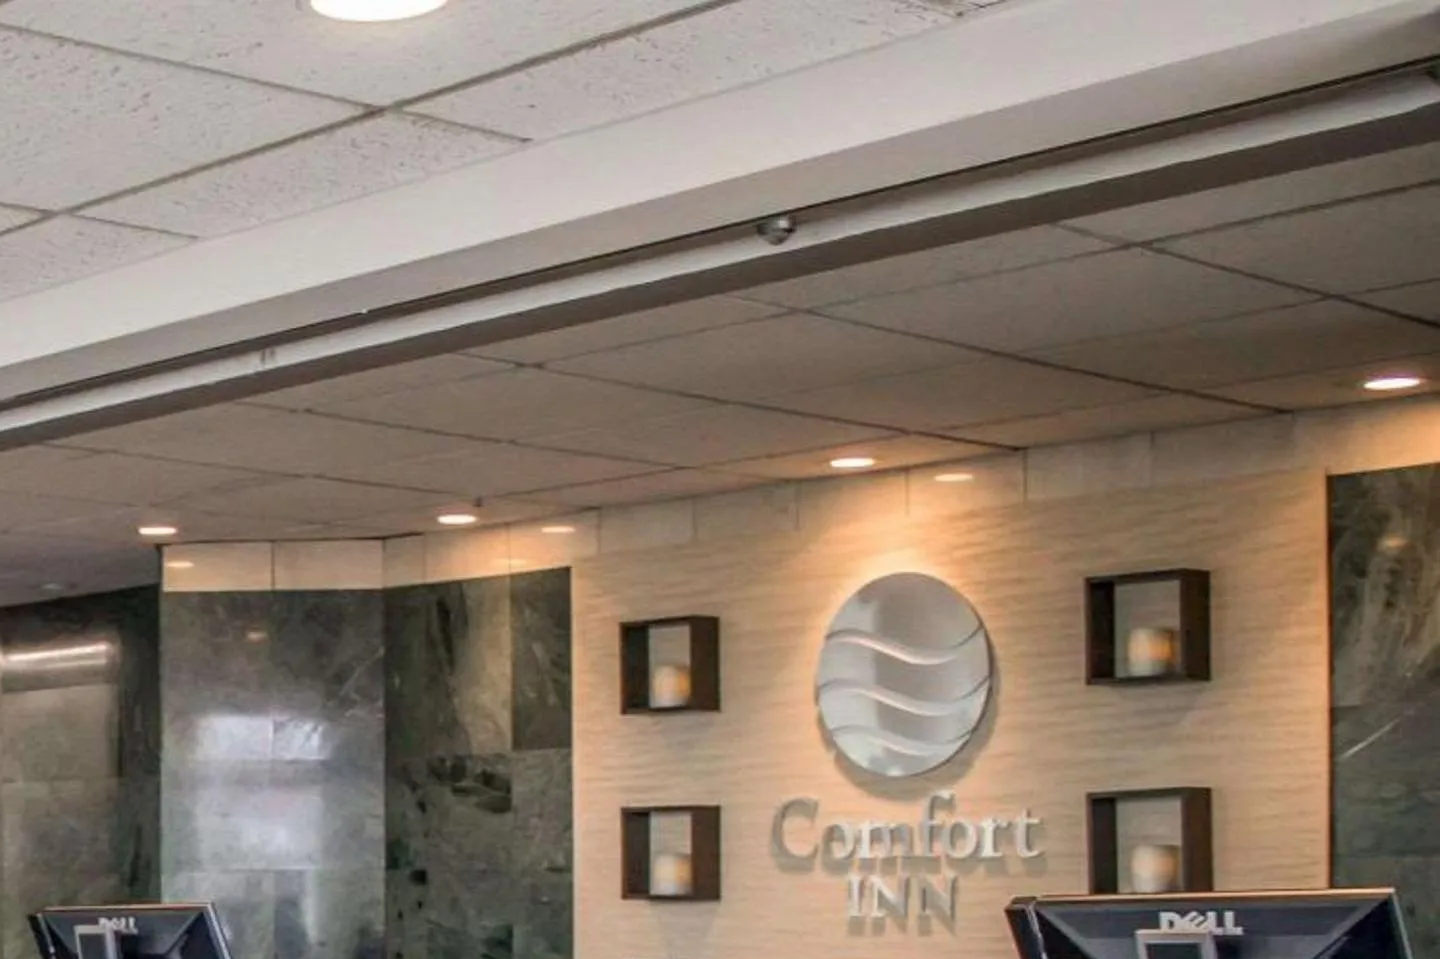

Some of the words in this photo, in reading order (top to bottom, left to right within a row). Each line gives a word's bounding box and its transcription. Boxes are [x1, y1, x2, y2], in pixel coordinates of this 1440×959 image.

[770, 789, 1044, 862] Comfort
[849, 873, 958, 920] INN
[1159, 911, 1244, 936] DELL
